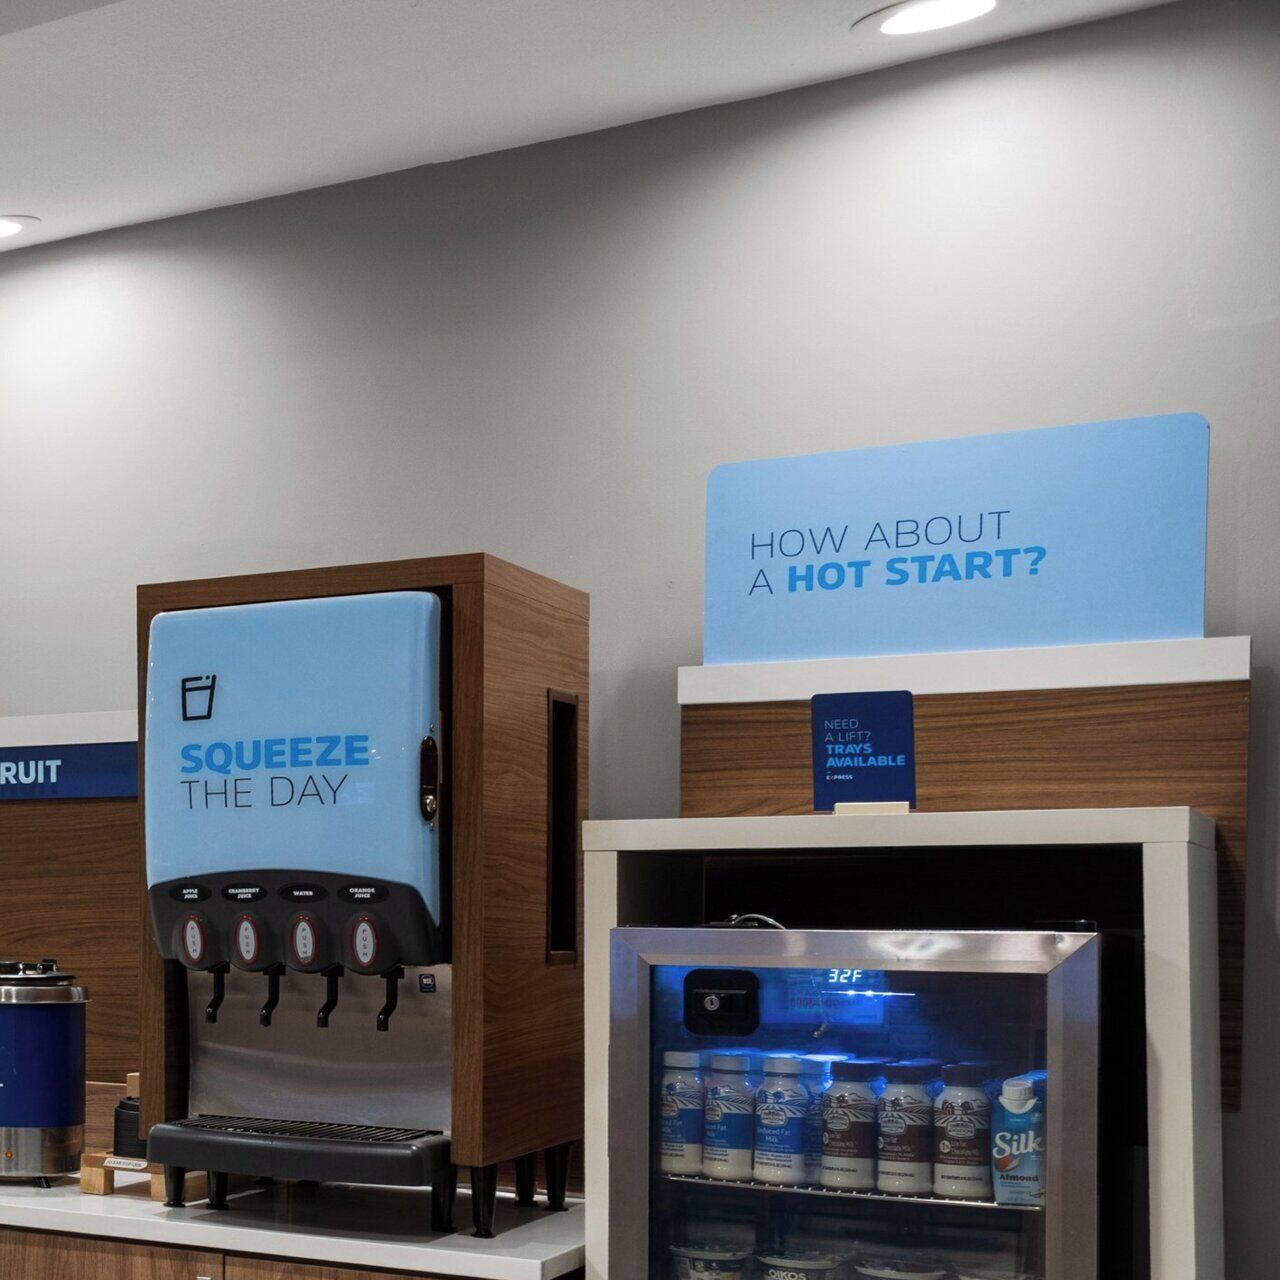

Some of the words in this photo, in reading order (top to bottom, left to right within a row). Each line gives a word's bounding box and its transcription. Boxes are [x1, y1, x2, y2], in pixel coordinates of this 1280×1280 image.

[750, 525, 848, 560] HOW
[864, 510, 1011, 551] ABOUT
[749, 569, 774, 596] A
[788, 560, 871, 592] HOT
[885, 546, 1047, 586] START?
[824, 719, 859, 730] NEED
[824, 732, 834, 742] A
[838, 731, 871, 742] LIFT?
[180, 735, 370, 775] SQUEEZE
[826, 743, 872, 755] TRAYS
[826, 755, 906, 768] AVAILABLE
[180, 778, 252, 809] THE
[270, 774, 348, 807] DAY
[828, 968, 863, 983] 32F
[992, 1130, 1045, 1159] Silk
